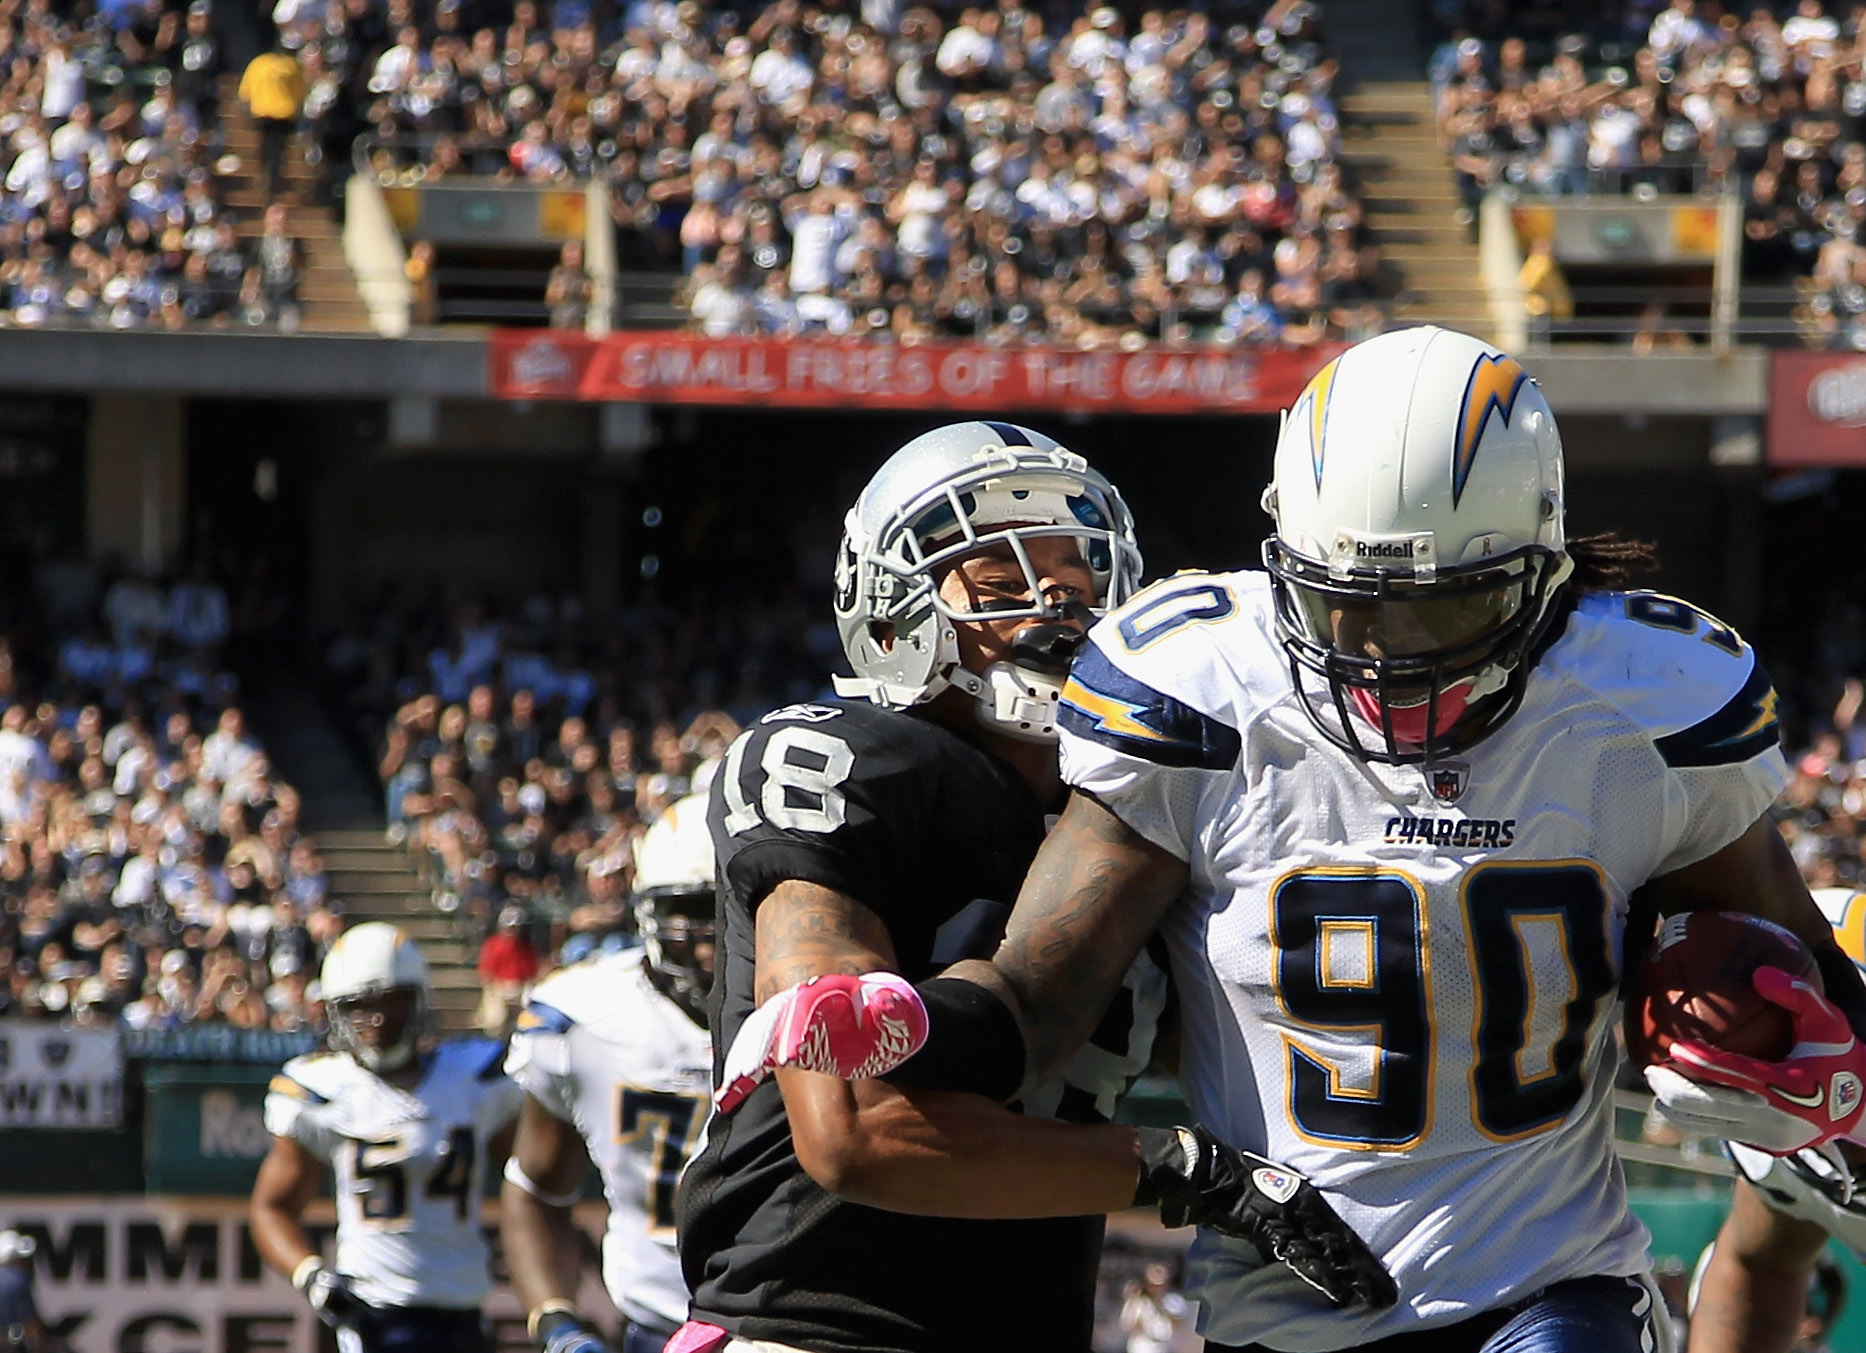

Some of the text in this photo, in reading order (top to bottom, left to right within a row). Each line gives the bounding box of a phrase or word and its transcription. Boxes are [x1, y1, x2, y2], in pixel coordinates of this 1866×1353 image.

[618, 343, 780, 392] SMALL
[939, 350, 1005, 397] OF
[1022, 351, 1118, 399] THE
[1356, 540, 1414, 558] Riddell
[722, 725, 856, 838] 18
[1384, 817, 1517, 848] CHARGERS
[1267, 857, 1623, 1152] 90
[352, 1122, 478, 1235] 54
